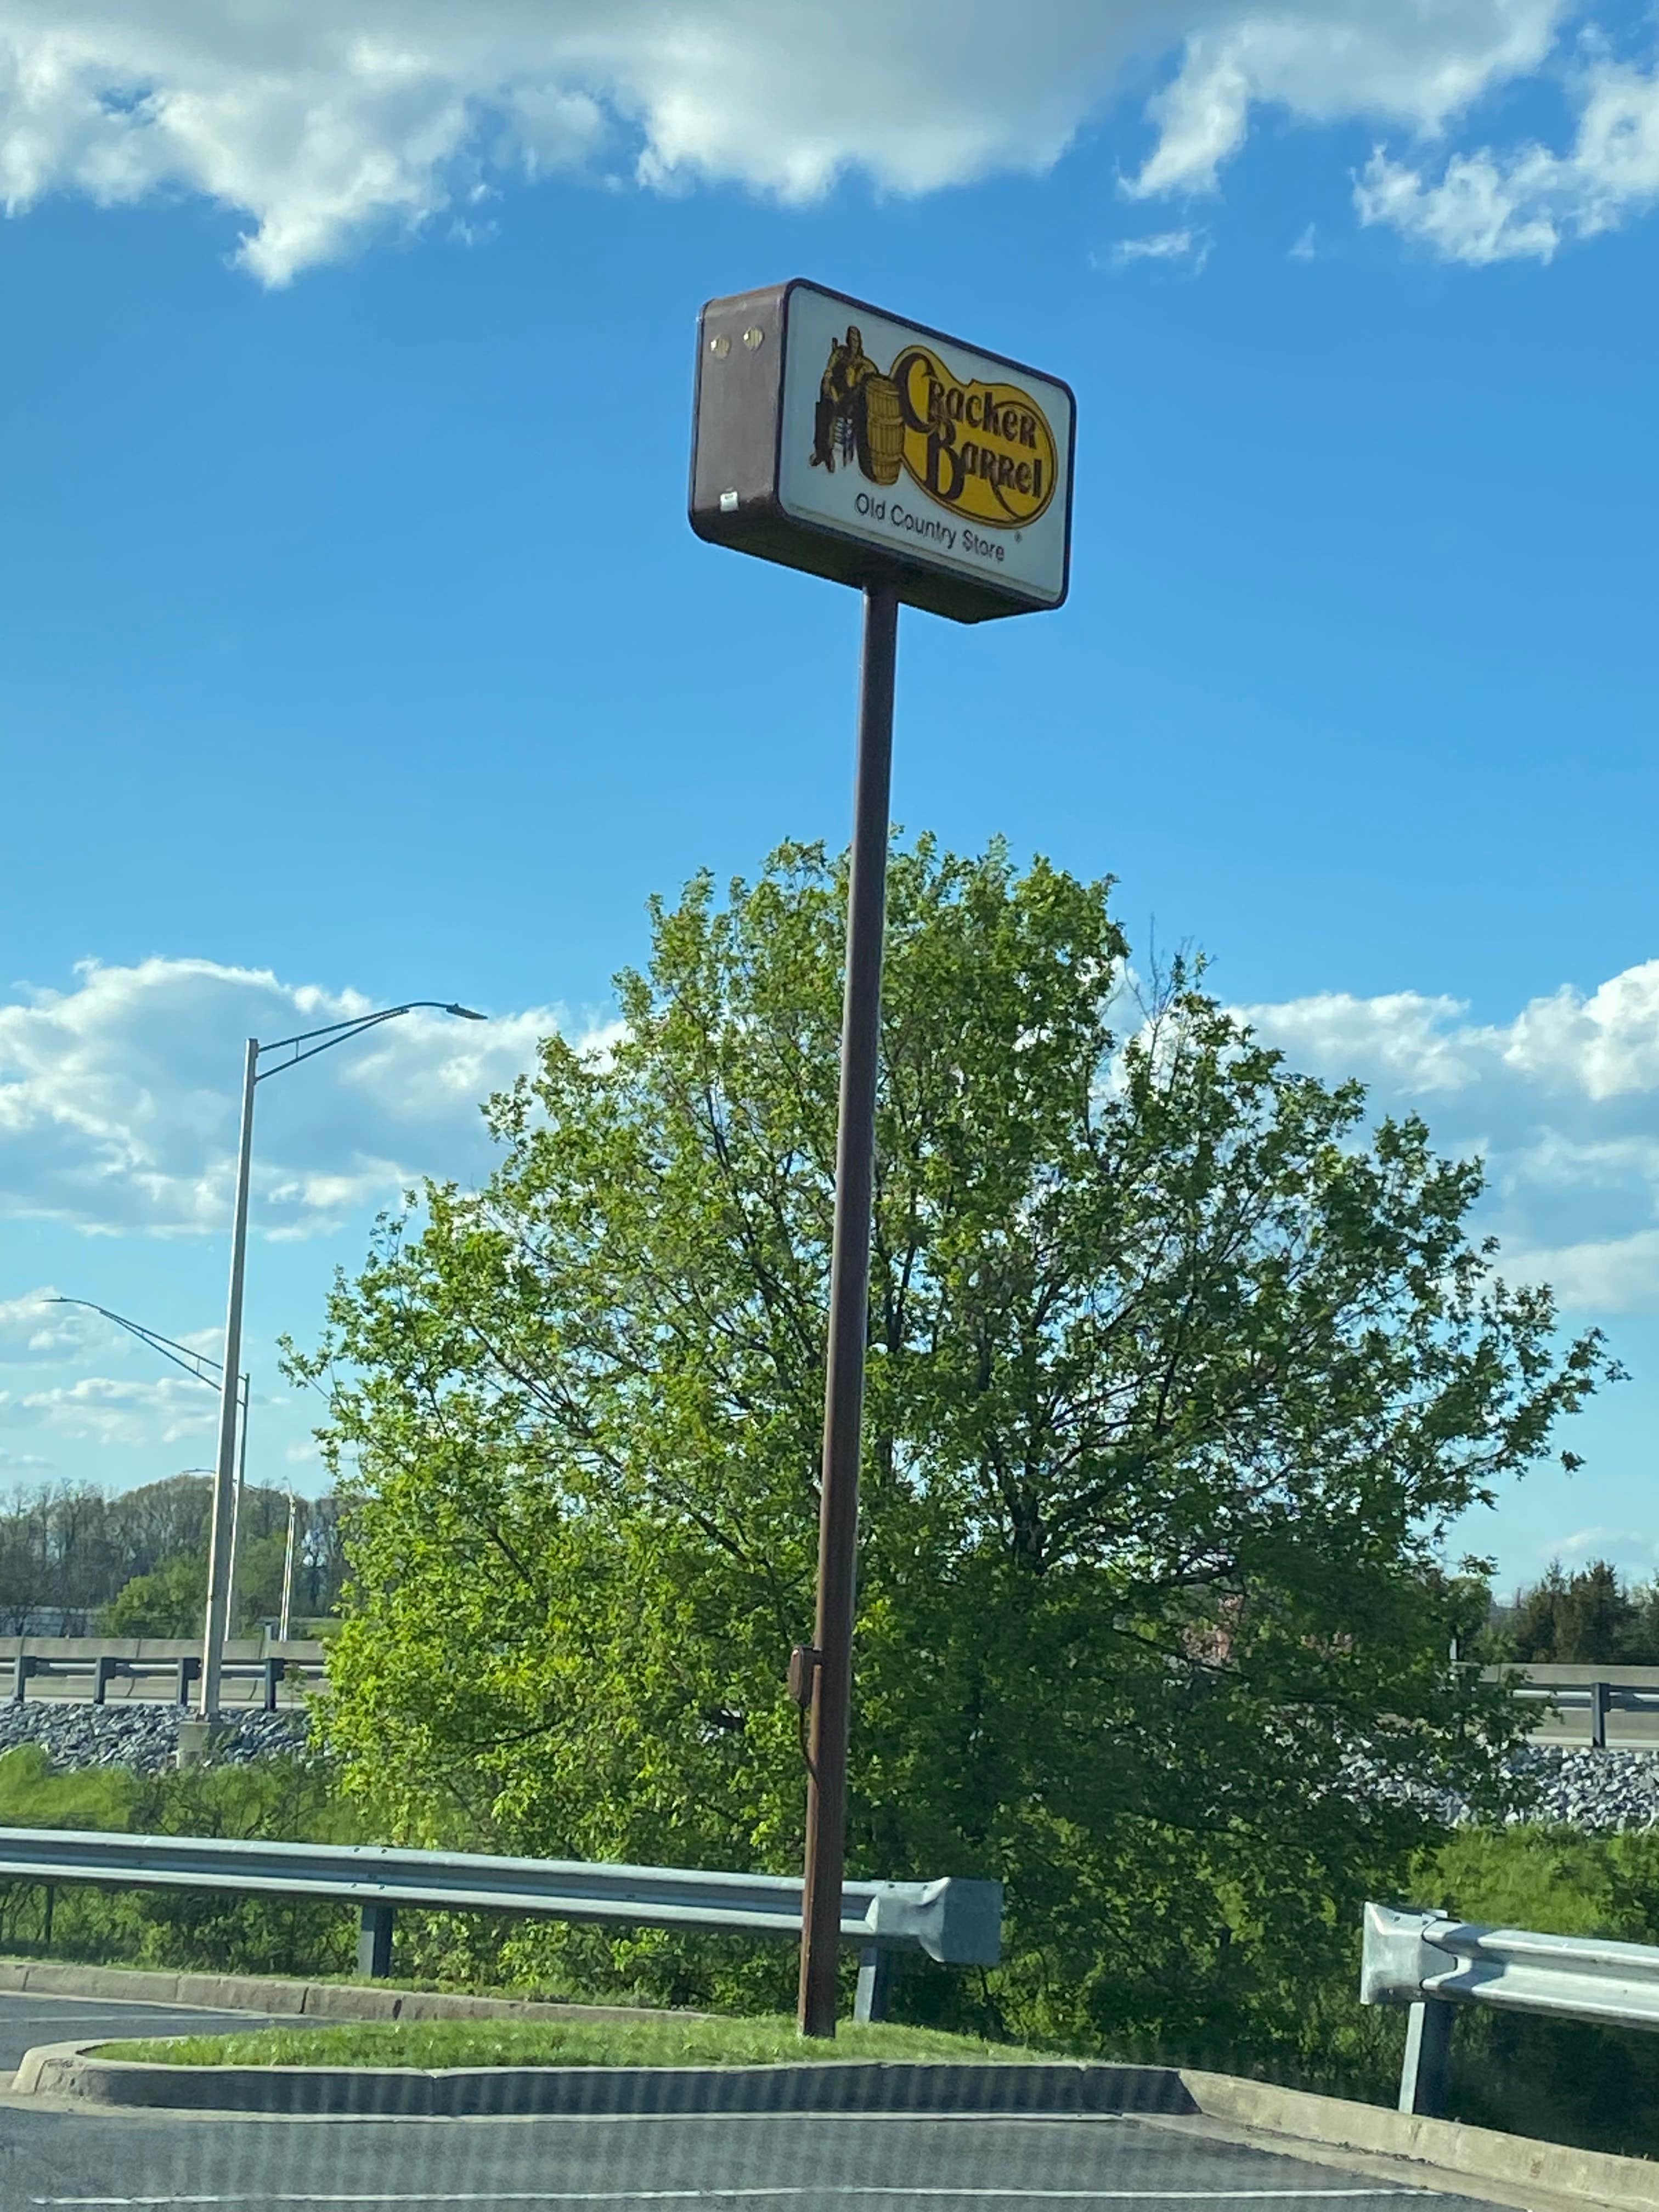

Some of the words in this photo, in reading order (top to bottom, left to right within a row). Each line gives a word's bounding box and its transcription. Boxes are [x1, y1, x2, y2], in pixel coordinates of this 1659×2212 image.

[855, 493, 885, 520] Old
[890, 504, 957, 549] Country
[963, 529, 1005, 562] Store
